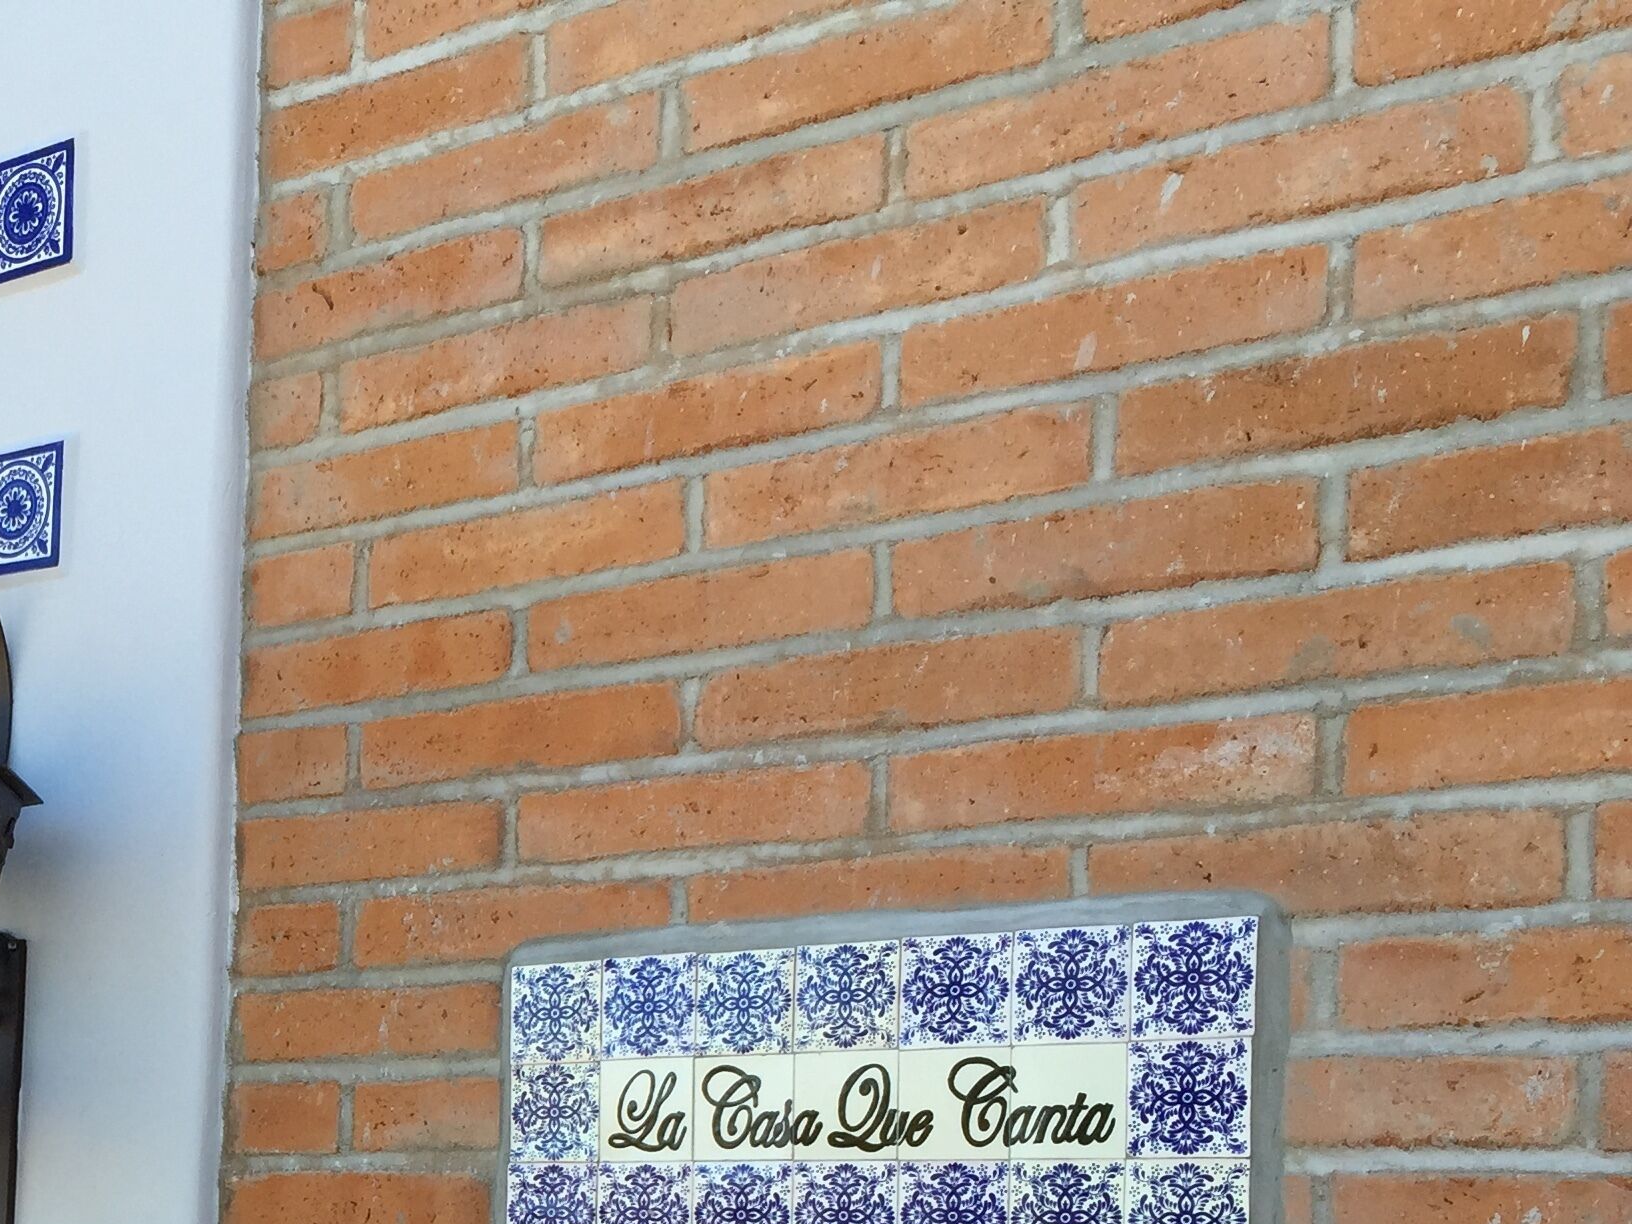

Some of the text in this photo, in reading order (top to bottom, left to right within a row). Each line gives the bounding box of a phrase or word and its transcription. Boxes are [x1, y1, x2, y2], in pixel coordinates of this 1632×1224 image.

[607, 1055, 1115, 1153] La Casa Que Canta
